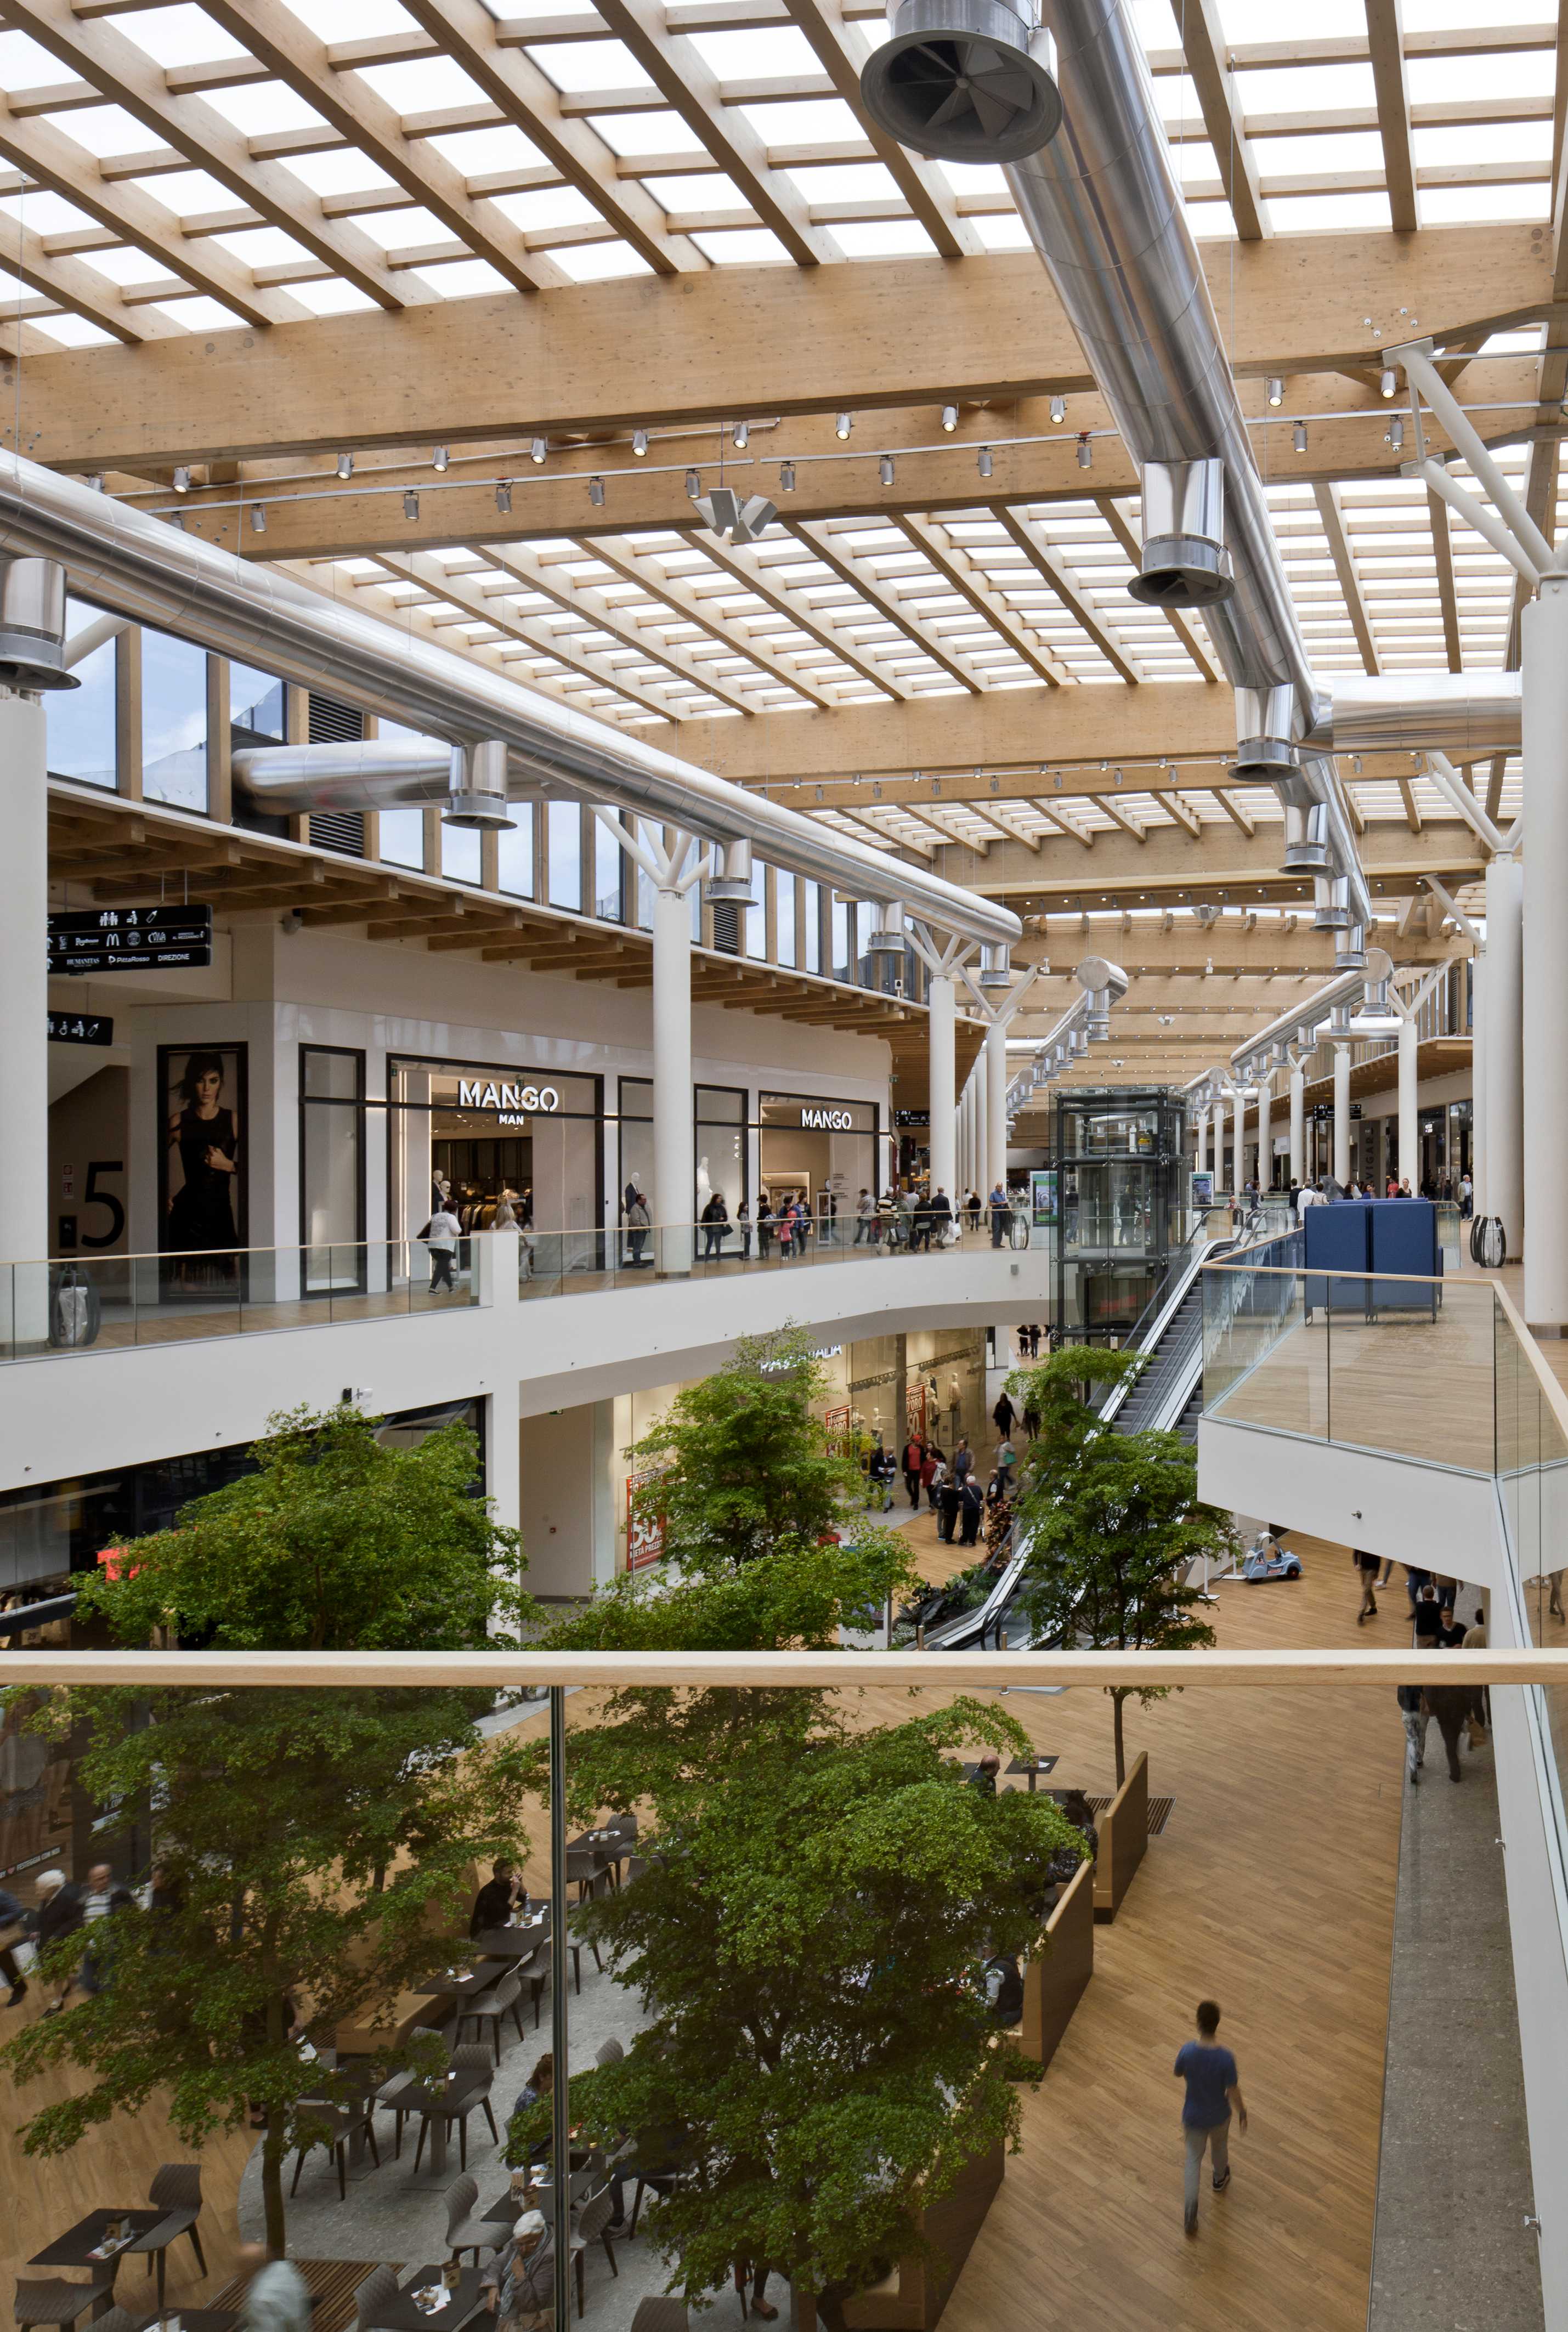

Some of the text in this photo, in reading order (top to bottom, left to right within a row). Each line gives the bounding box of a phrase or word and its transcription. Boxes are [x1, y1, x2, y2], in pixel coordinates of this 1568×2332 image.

[157, 953, 190, 961] DIREZIONE
[457, 1080, 559, 1112] MANGO
[499, 1114, 524, 1125] MAN
[801, 1108, 852, 1130] MANGO
[81, 1161, 124, 1248] 5
